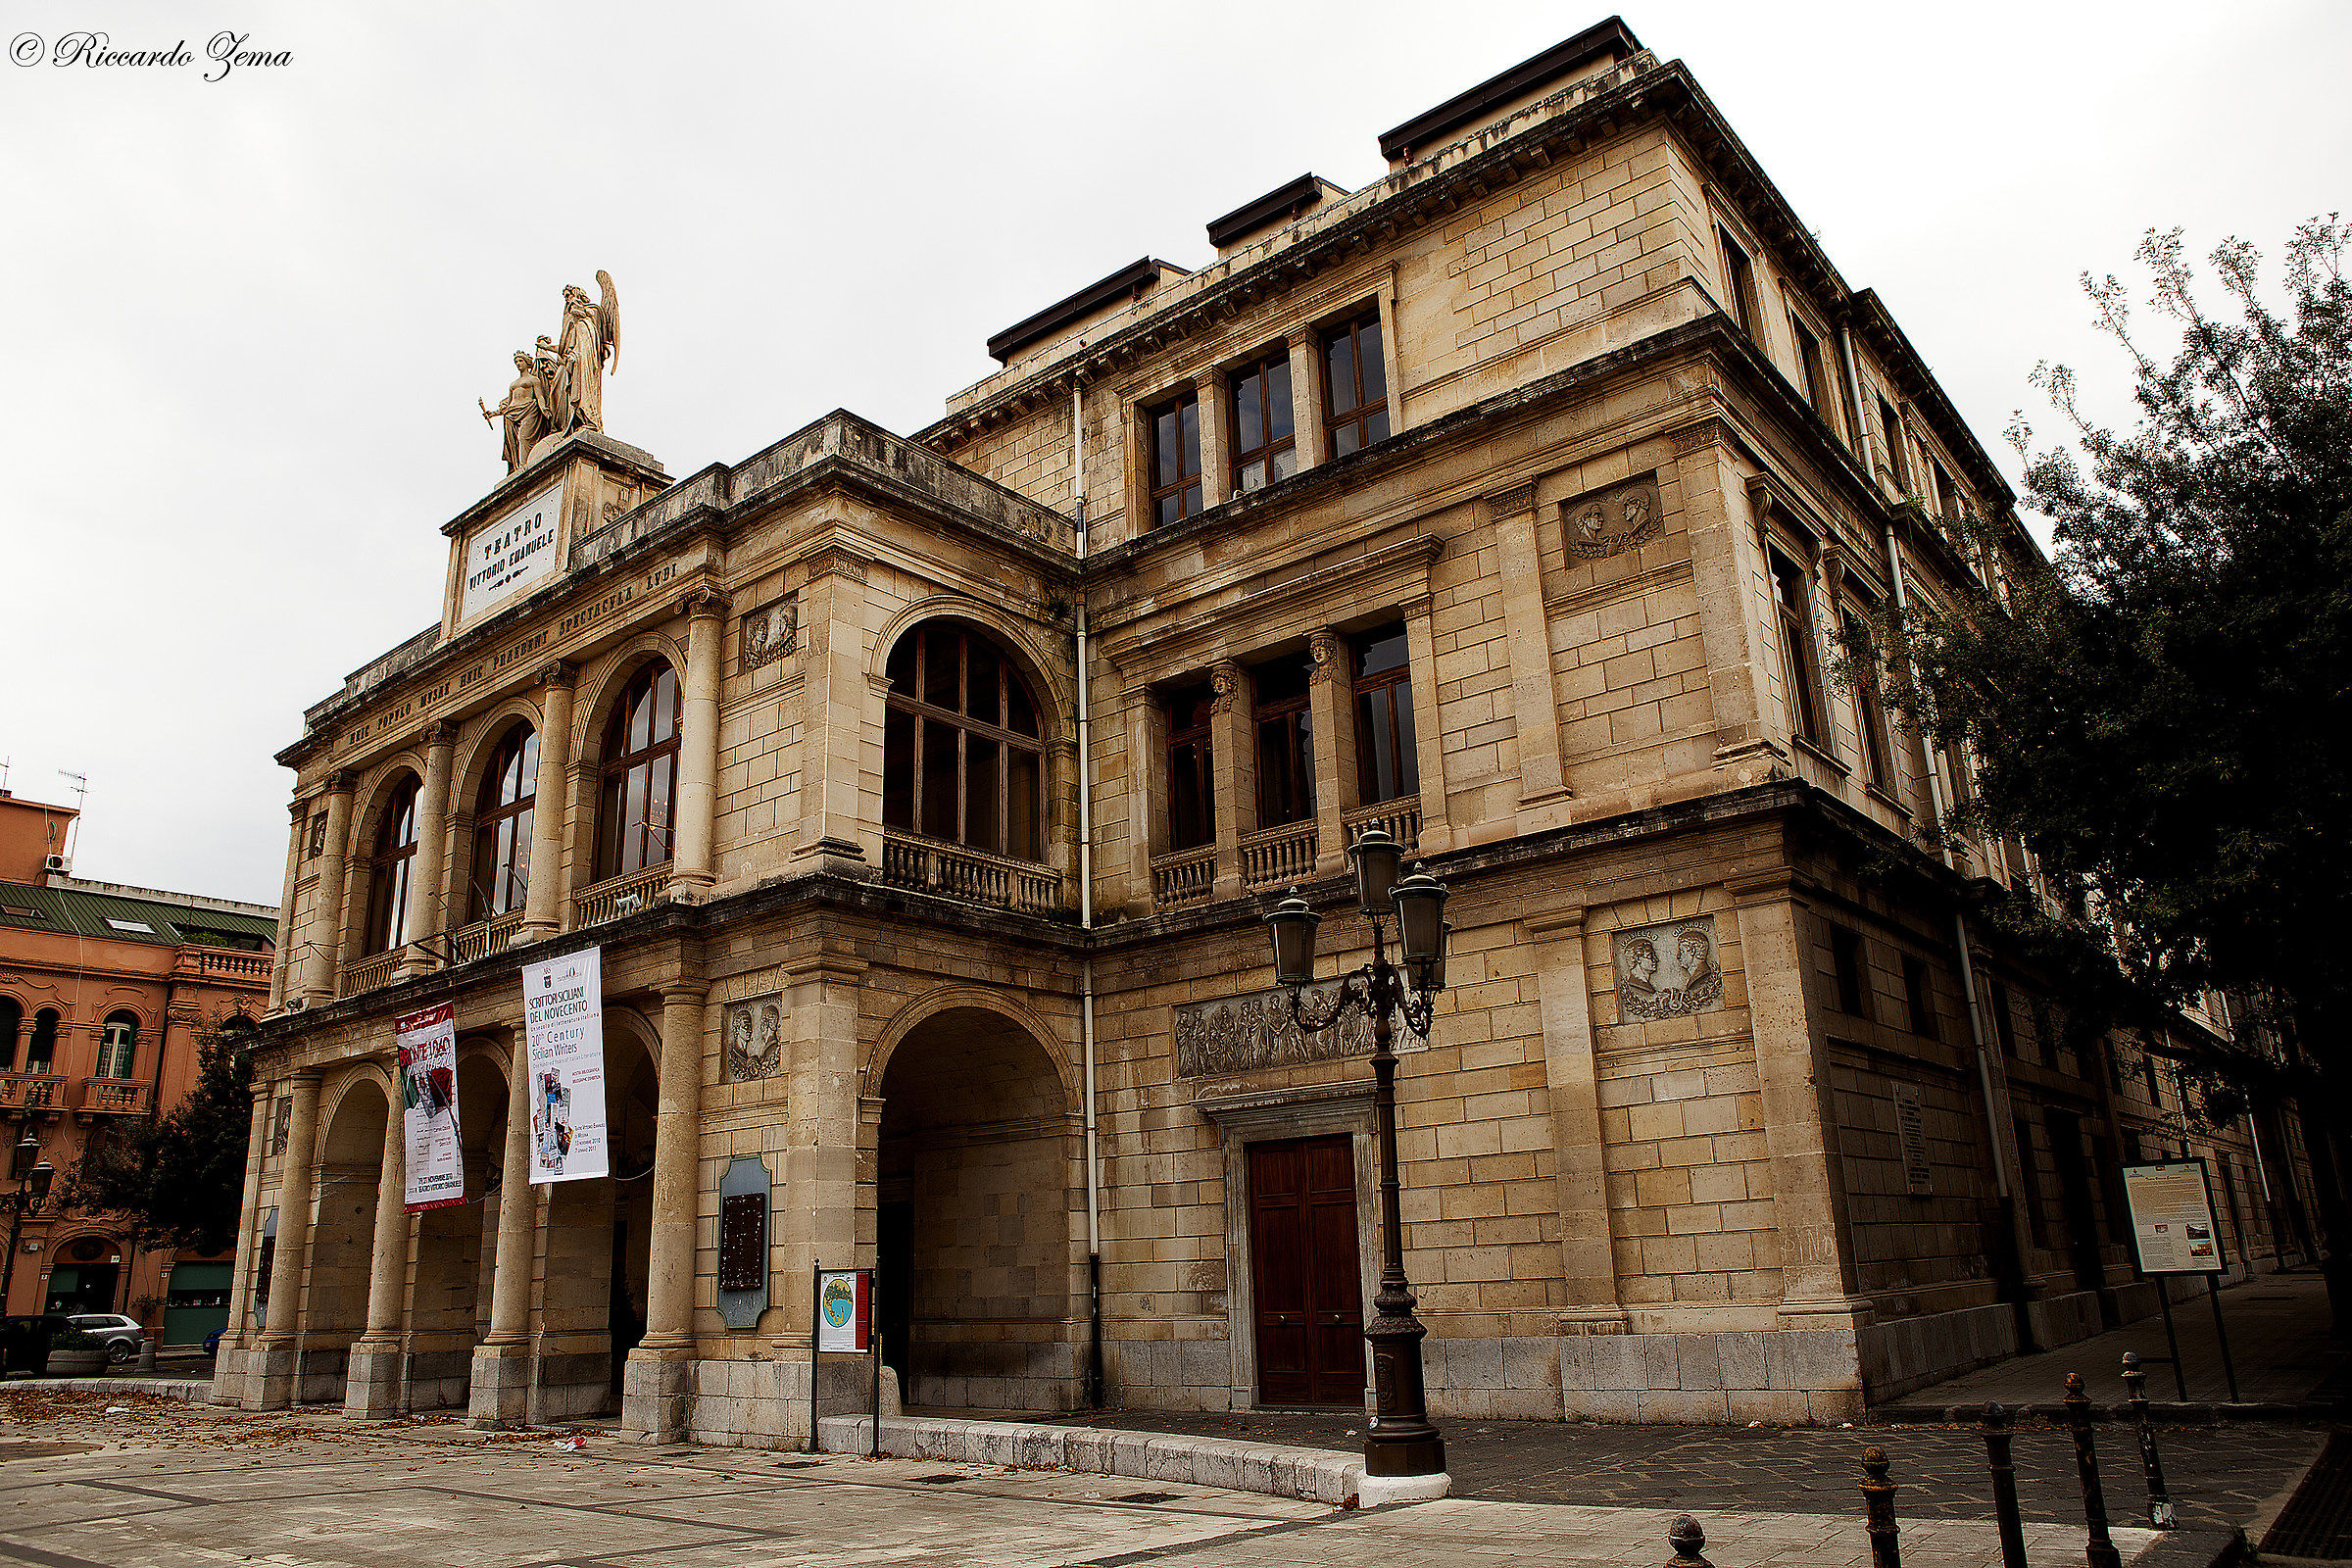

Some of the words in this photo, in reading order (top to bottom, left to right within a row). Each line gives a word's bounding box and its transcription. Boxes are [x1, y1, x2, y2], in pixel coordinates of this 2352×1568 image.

[484, 513, 542, 561] TEATRO
[468, 559, 506, 590] VITTORIO
[509, 529, 555, 567] EMANUELE
[559, 586, 633, 636] SPECTACVLA
[647, 563, 677, 590] LVDI
[1672, 921, 1710, 938] CIMAROSA
[529, 992, 558, 1009] SCRITTORI
[558, 986, 584, 1003] SICILIANI
[530, 1010, 542, 1024] DEL
[544, 1000, 588, 1021] NOVECENTO
[547, 1027, 585, 1044] Century
[399, 1043, 428, 1067] BRONTE
[532, 1047, 554, 1061] Sicilian
[554, 1043, 578, 1056] Writers
